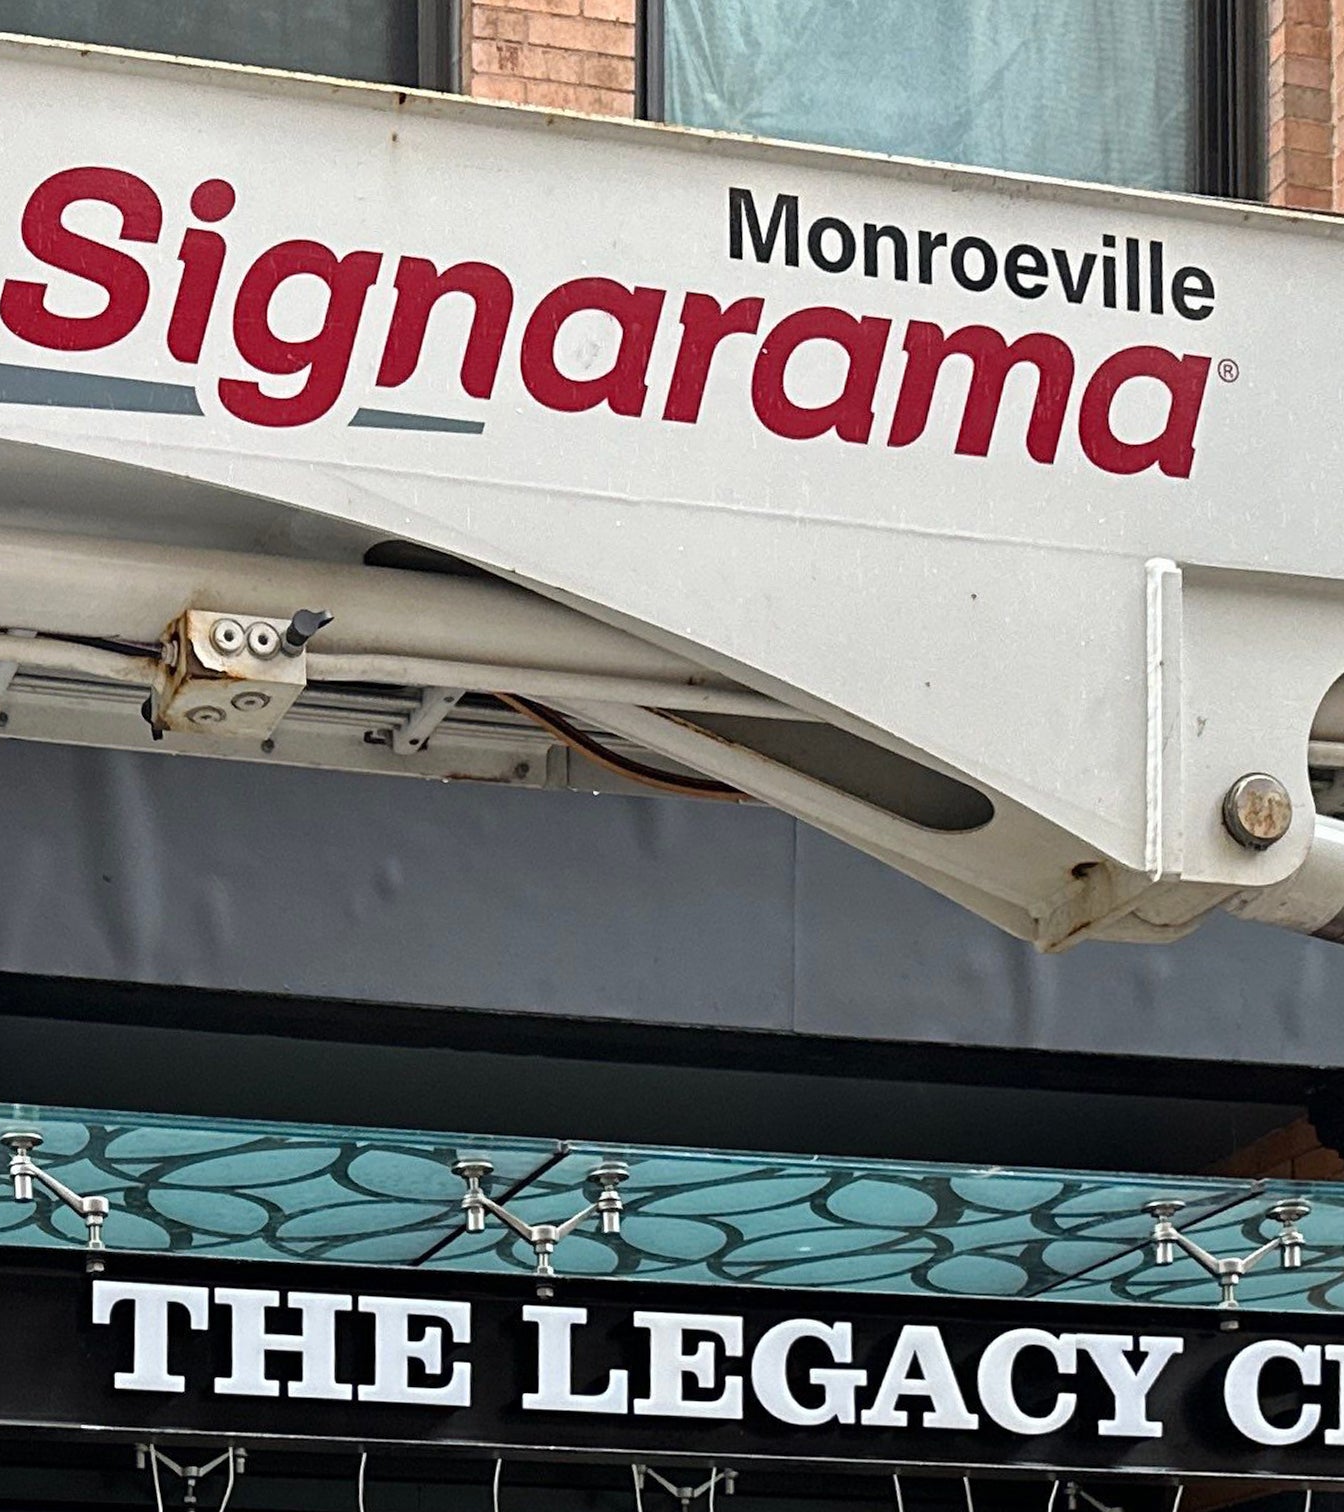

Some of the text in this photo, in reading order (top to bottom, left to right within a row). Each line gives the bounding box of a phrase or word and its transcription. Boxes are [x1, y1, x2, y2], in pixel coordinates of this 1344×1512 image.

[728, 187, 1215, 321] Monroeville
[92, 1280, 471, 1407] THE
[522, 1304, 1183, 1438] LEGACY
